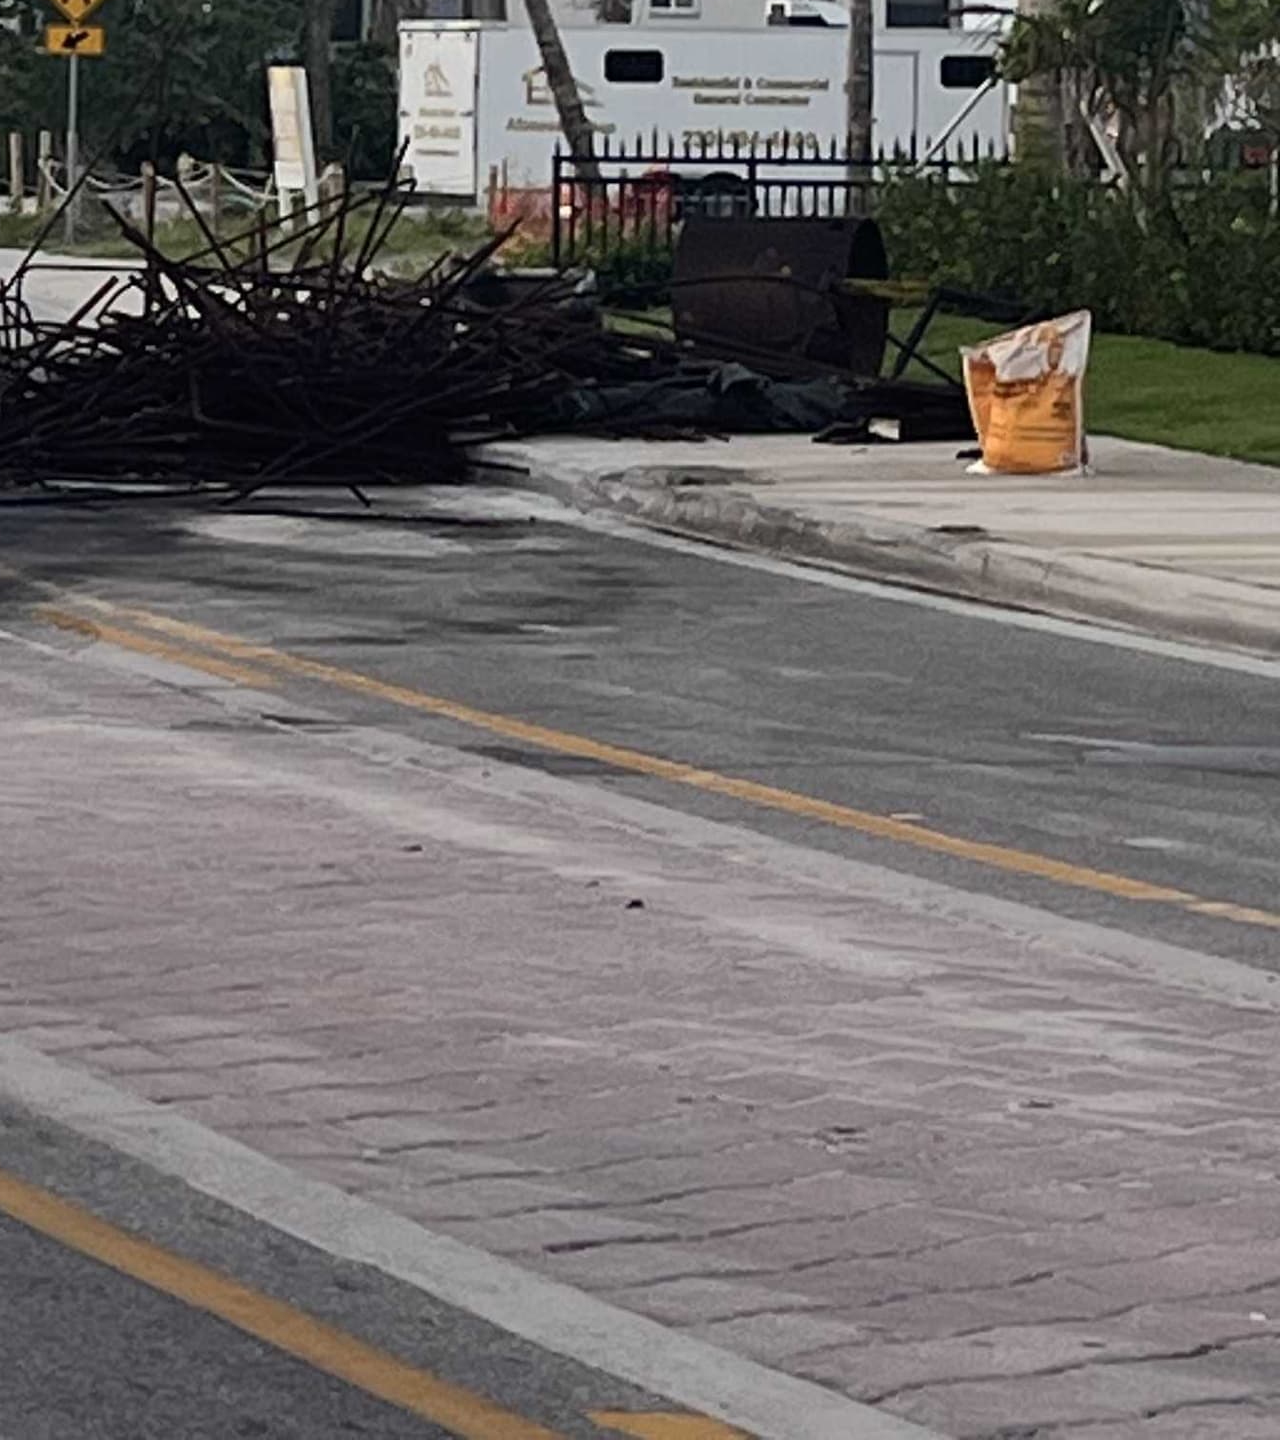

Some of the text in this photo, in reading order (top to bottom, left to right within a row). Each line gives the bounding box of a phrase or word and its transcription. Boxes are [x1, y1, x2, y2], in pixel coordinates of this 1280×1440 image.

[671, 75, 829, 90] Residential & Commercial
[693, 92, 740, 105] General
